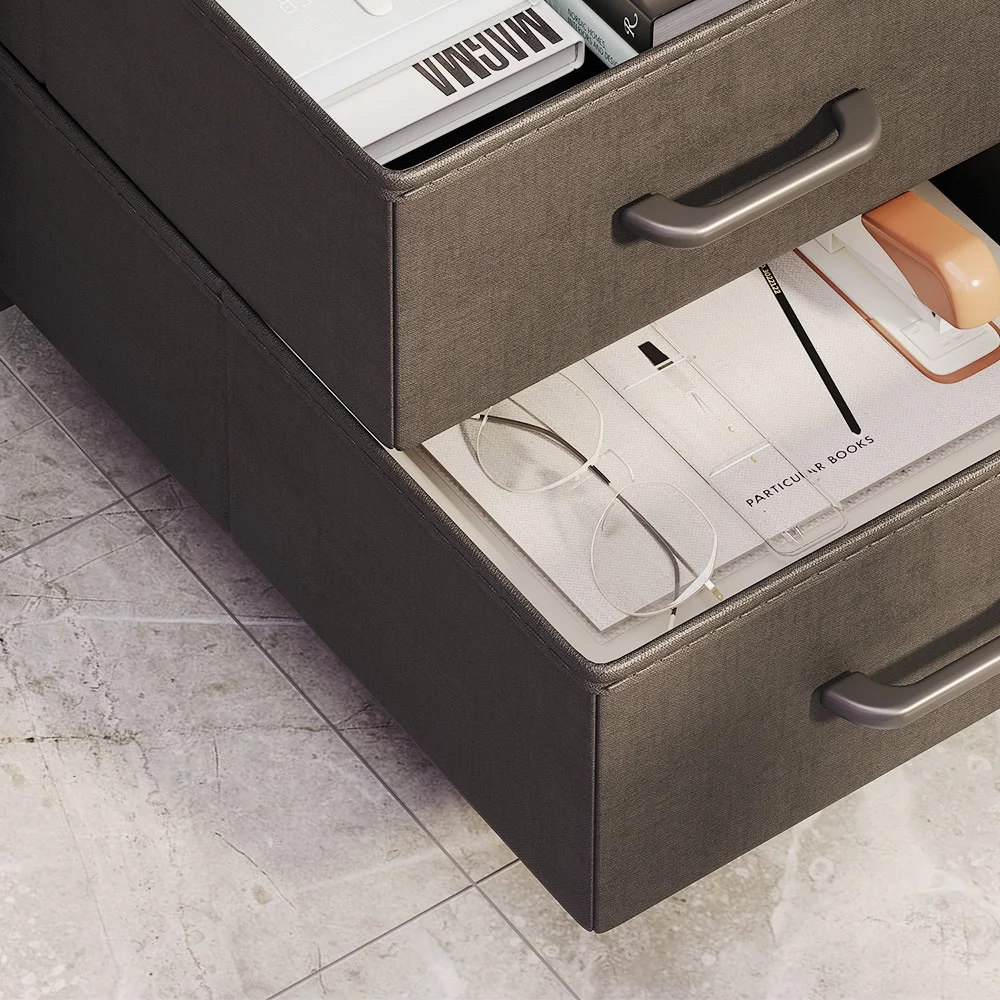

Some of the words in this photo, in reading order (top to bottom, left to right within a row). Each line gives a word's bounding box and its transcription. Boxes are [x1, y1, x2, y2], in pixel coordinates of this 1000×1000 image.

[412, 7, 563, 97] MAGMA
[746, 462, 826, 507] PARTICUR
[827, 435, 875, 464] BOOKS
